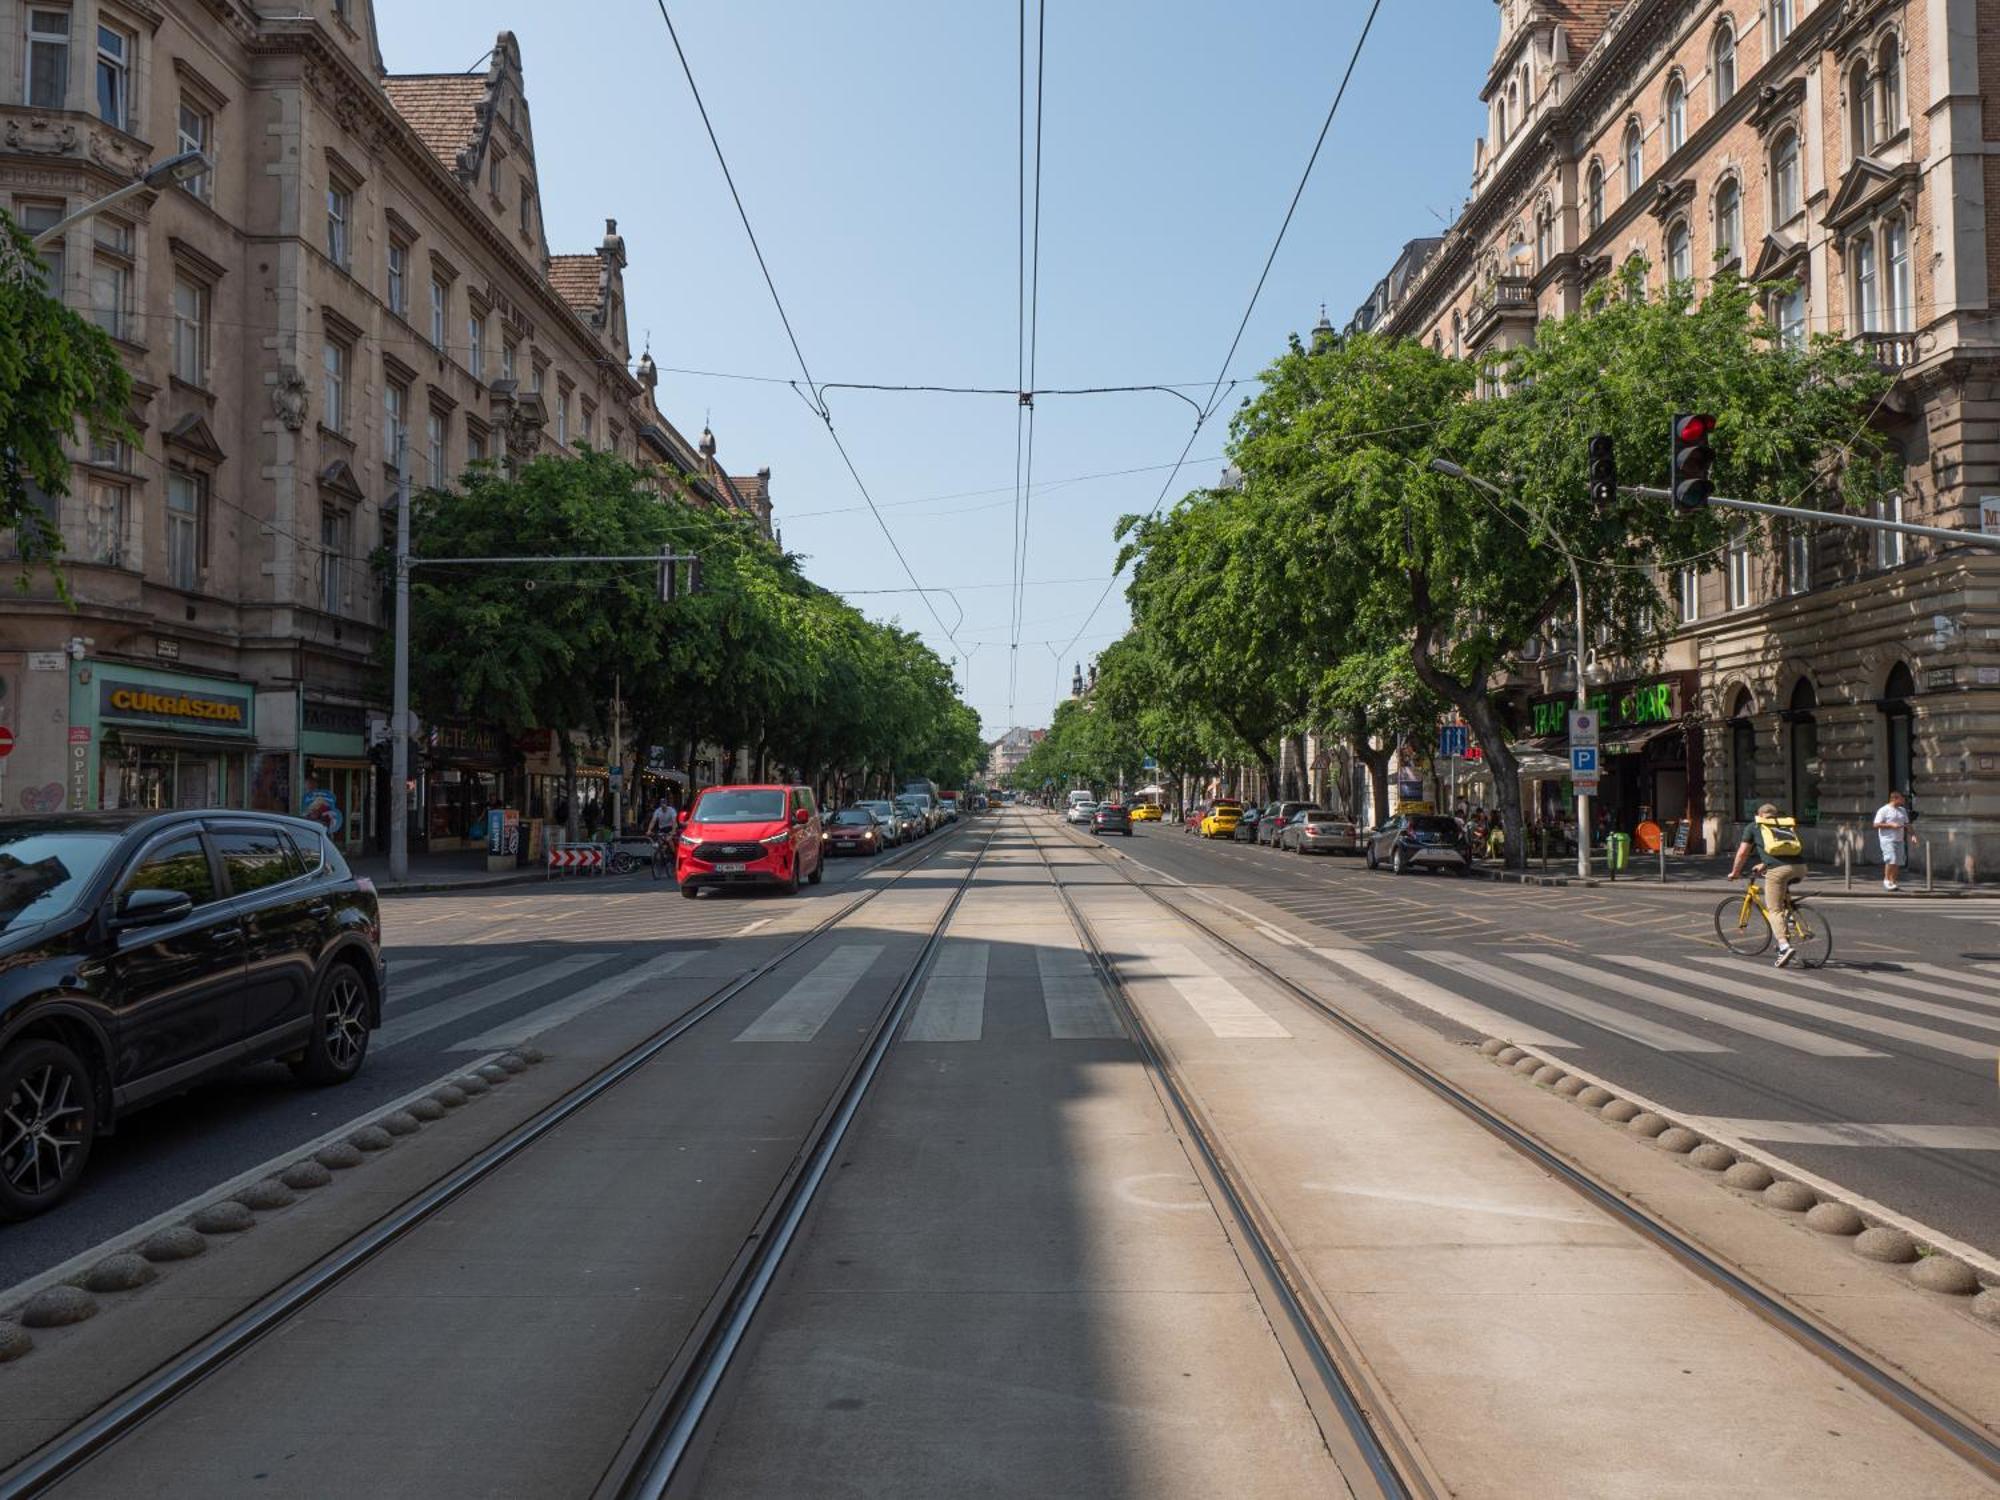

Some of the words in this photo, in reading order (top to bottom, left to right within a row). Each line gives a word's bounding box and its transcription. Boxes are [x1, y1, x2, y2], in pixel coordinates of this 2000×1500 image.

[111, 688, 242, 721] CUKRÁSZDA
[1533, 701, 1566, 736] TRAP
[1636, 683, 1673, 722] BAR
[1578, 751, 1590, 769] P
